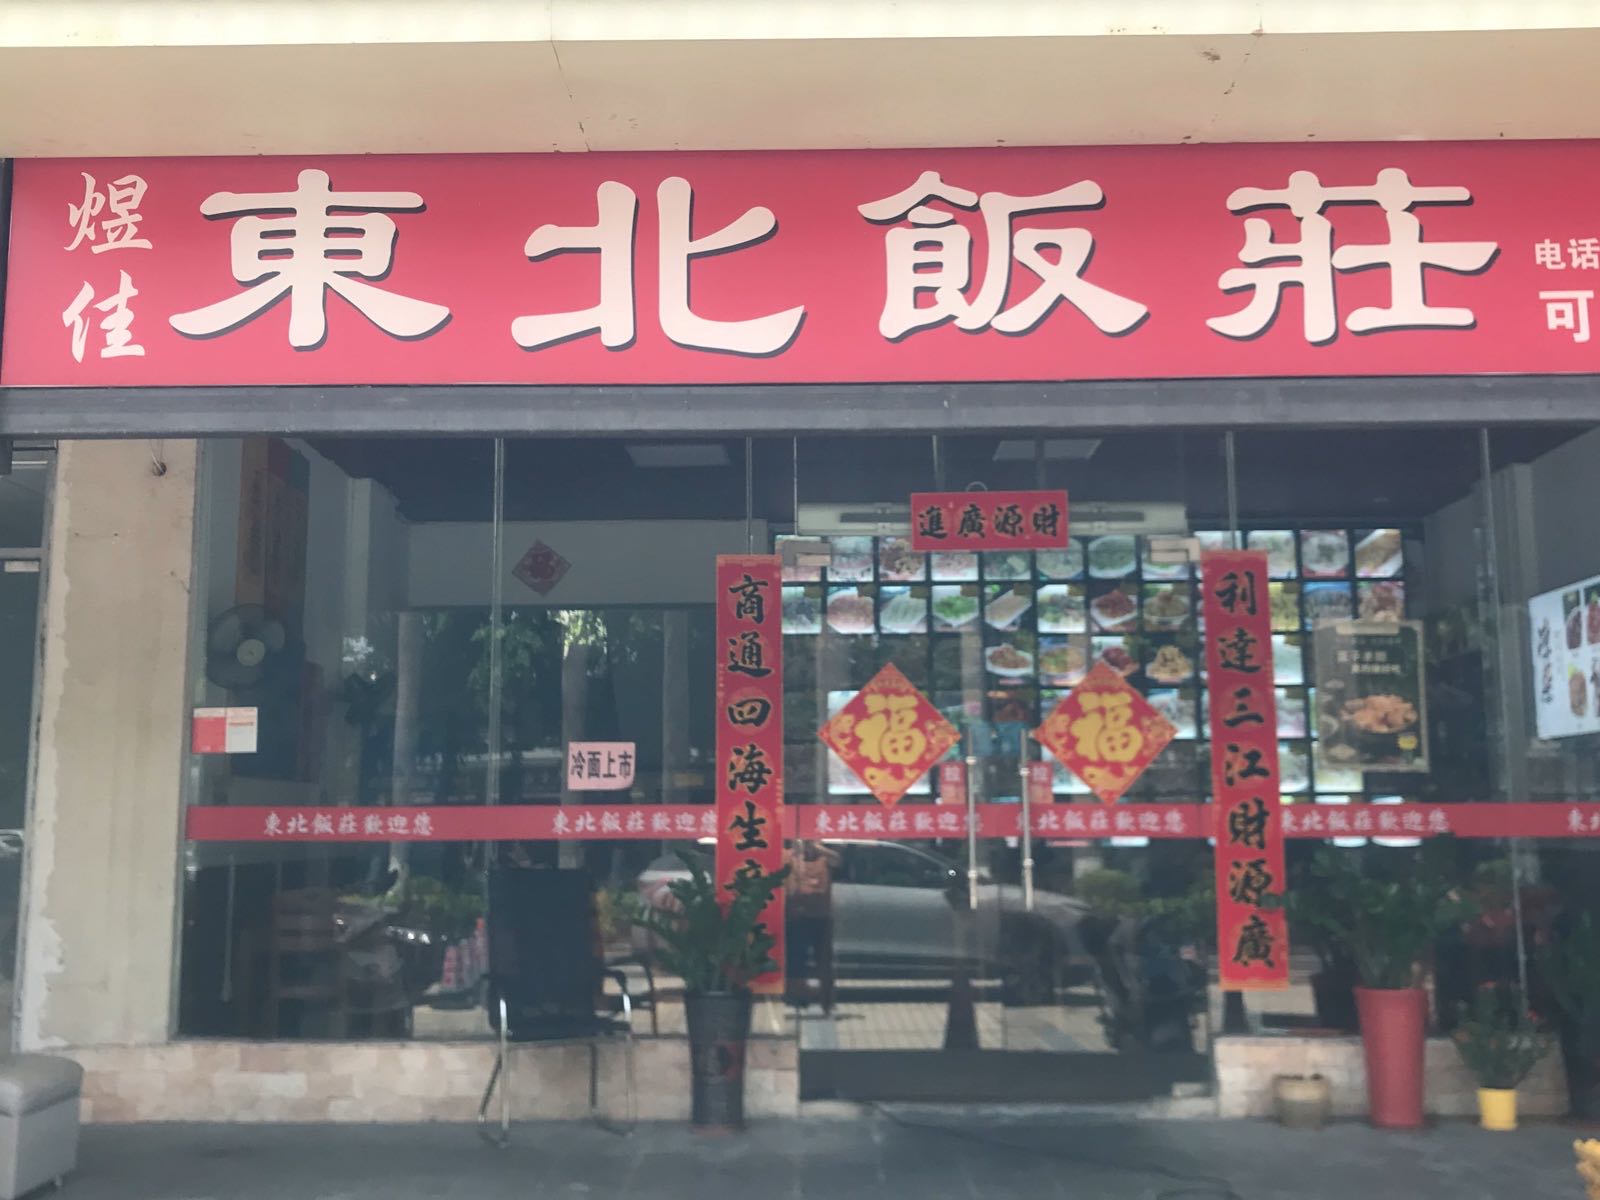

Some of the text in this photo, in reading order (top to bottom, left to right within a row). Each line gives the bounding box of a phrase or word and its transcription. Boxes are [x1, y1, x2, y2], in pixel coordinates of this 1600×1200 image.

[63, 172, 153, 363] 煜佳
[1534, 237, 1600, 270] 电话
[1538, 289, 1595, 343] 可
[854, 693, 927, 766] 福
[1070, 691, 1144, 763] 福
[571, 749, 633, 779] 冷面上市
